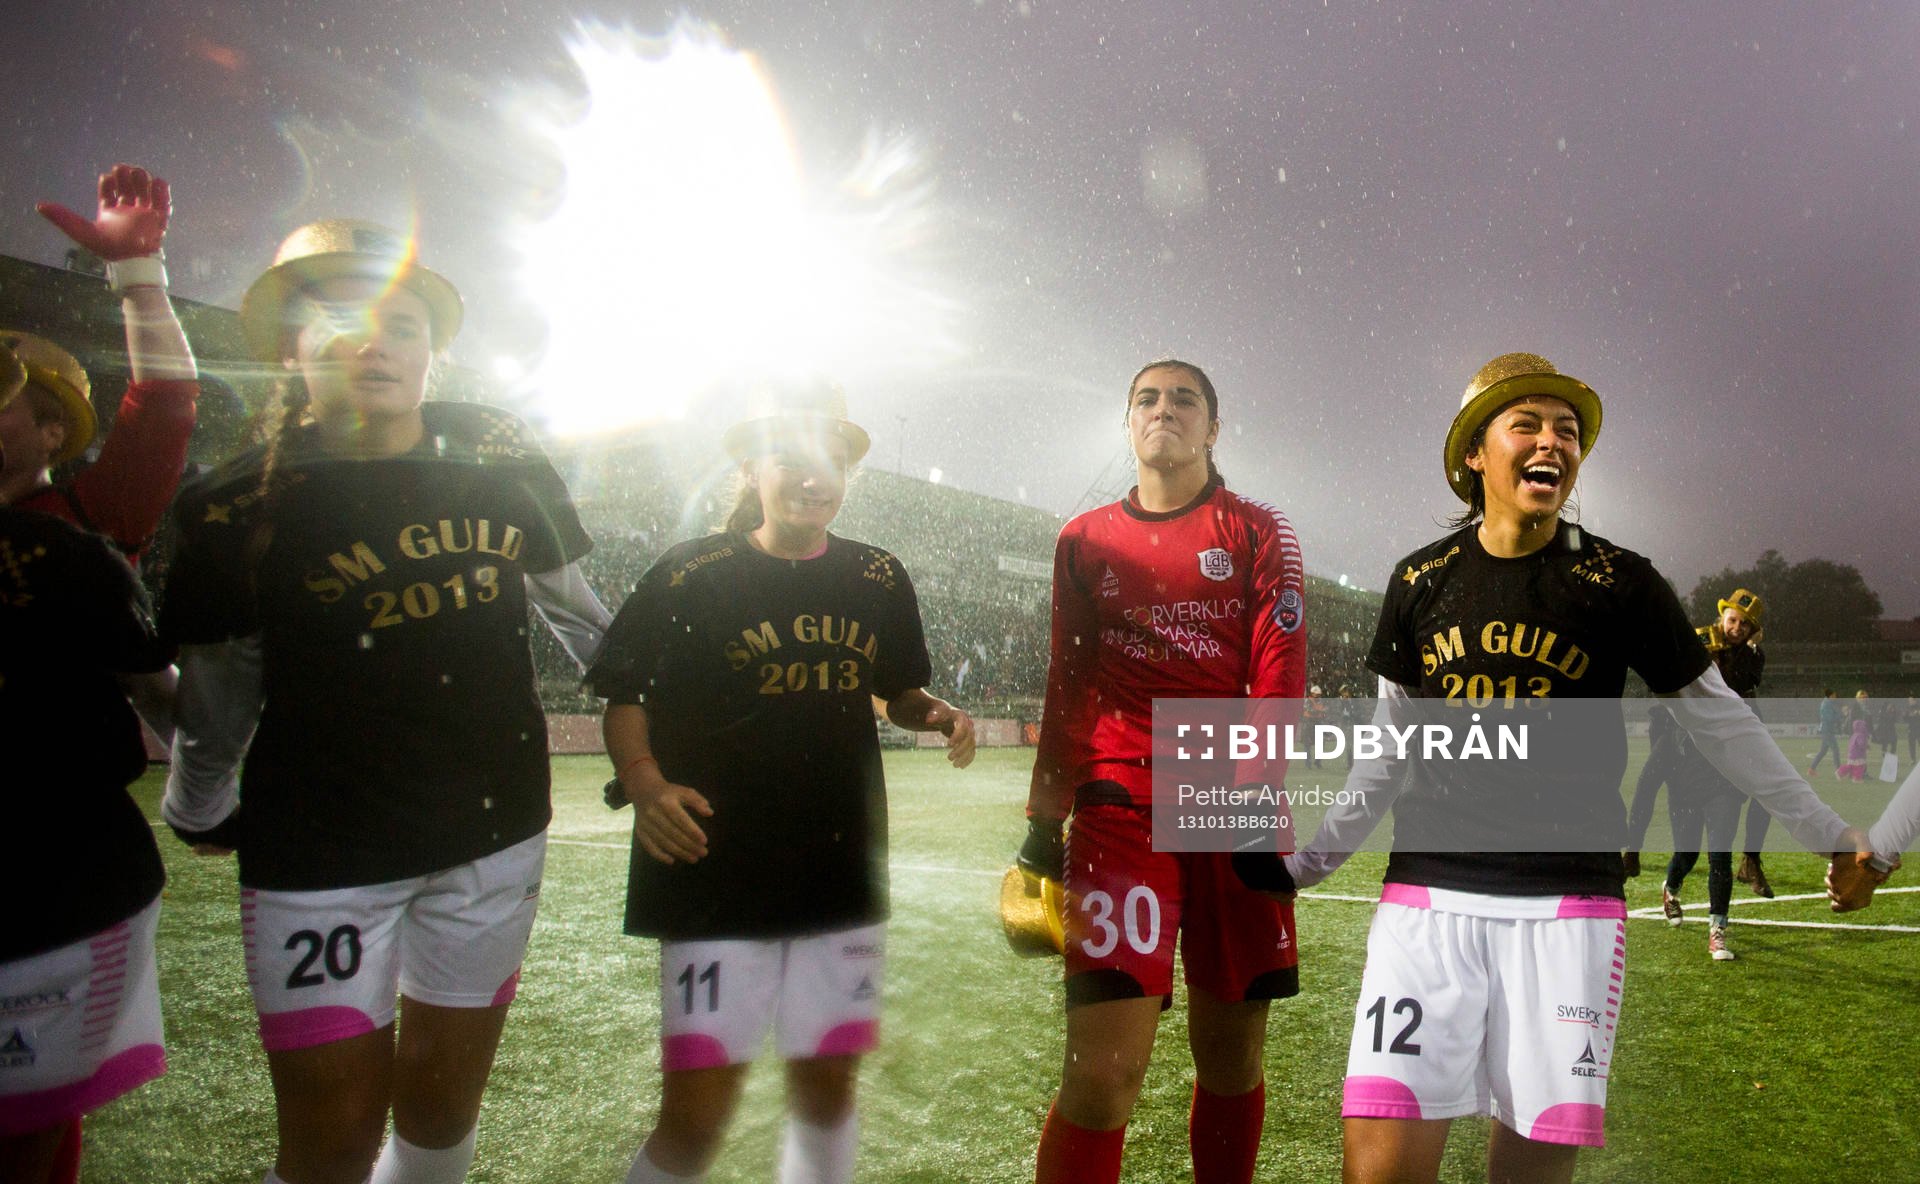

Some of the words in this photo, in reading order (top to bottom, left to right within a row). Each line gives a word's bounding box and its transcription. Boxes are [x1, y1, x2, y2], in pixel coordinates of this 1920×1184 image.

[303, 541, 386, 602] SM
[399, 519, 524, 561] GULD
[363, 566, 500, 629] 2013
[723, 620, 782, 672] SM
[793, 614, 880, 665] GULD
[1421, 625, 1467, 677] SM
[1480, 620, 1590, 681] GULD
[758, 659, 860, 695] 2013
[1441, 673, 1553, 711] 2013
[1081, 885, 1161, 959] 30
[285, 924, 362, 990] 20
[677, 960, 721, 1015] 11
[1366, 995, 1423, 1056] 12
[1571, 1066, 1597, 1078] SELEC
